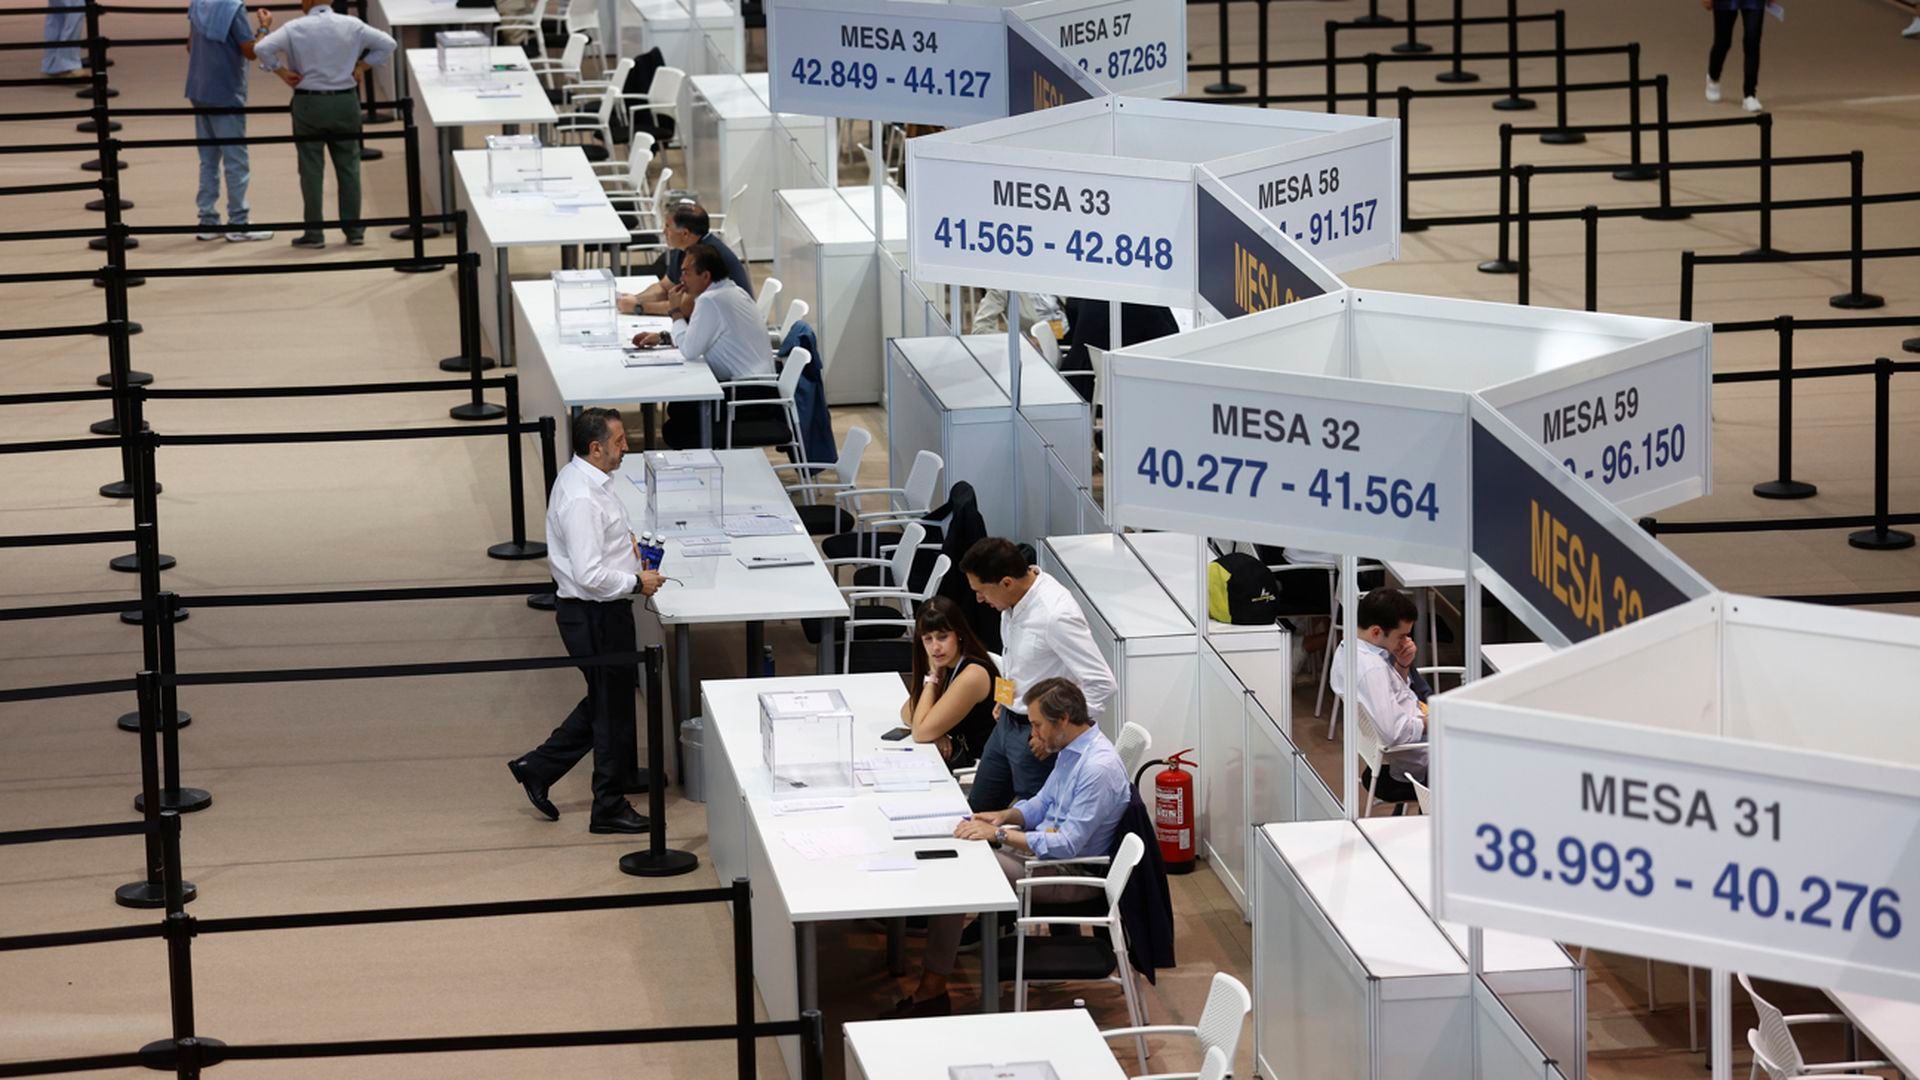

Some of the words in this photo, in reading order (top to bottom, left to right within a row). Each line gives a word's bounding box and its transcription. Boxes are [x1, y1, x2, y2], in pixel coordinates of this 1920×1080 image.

[842, 25, 904, 51] MESA
[913, 31, 938, 53] 34
[1060, 18, 1108, 48] MESA
[1113, 13, 1131, 37] 57
[792, 58, 877, 90] 42.849
[904, 66, 990, 98] 44.127
[1094, 67, 1102, 75] -
[1108, 41, 1166, 79] 87.263
[994, 180, 1071, 212] MESA
[1080, 189, 1110, 215] 33
[1259, 173, 1313, 209] MESA
[1319, 167, 1339, 195] 58
[935, 217, 1033, 256] 41.565
[1044, 242, 1056, 250] -
[1066, 230, 1172, 270] 42.848
[1295, 232, 1303, 240] -
[1310, 199, 1377, 245] 91.157
[1213, 404, 1310, 445] MESA
[1322, 418, 1359, 451] 32
[1544, 397, 1607, 444] MESA
[1615, 387, 1638, 422] 59
[1584, 469, 1594, 480] -
[1602, 423, 1684, 484] 96.150
[1138, 447, 1267, 497] 40.277
[1281, 482, 1295, 492] -
[1309, 469, 1439, 521] 41.564
[1531, 500, 1605, 635] MESA
[1582, 773, 1717, 831] MESA
[1735, 798, 1780, 841] 31
[1476, 824, 1654, 897] 38.993
[1674, 878, 1693, 890] -
[1713, 863, 1901, 939] 40.276
